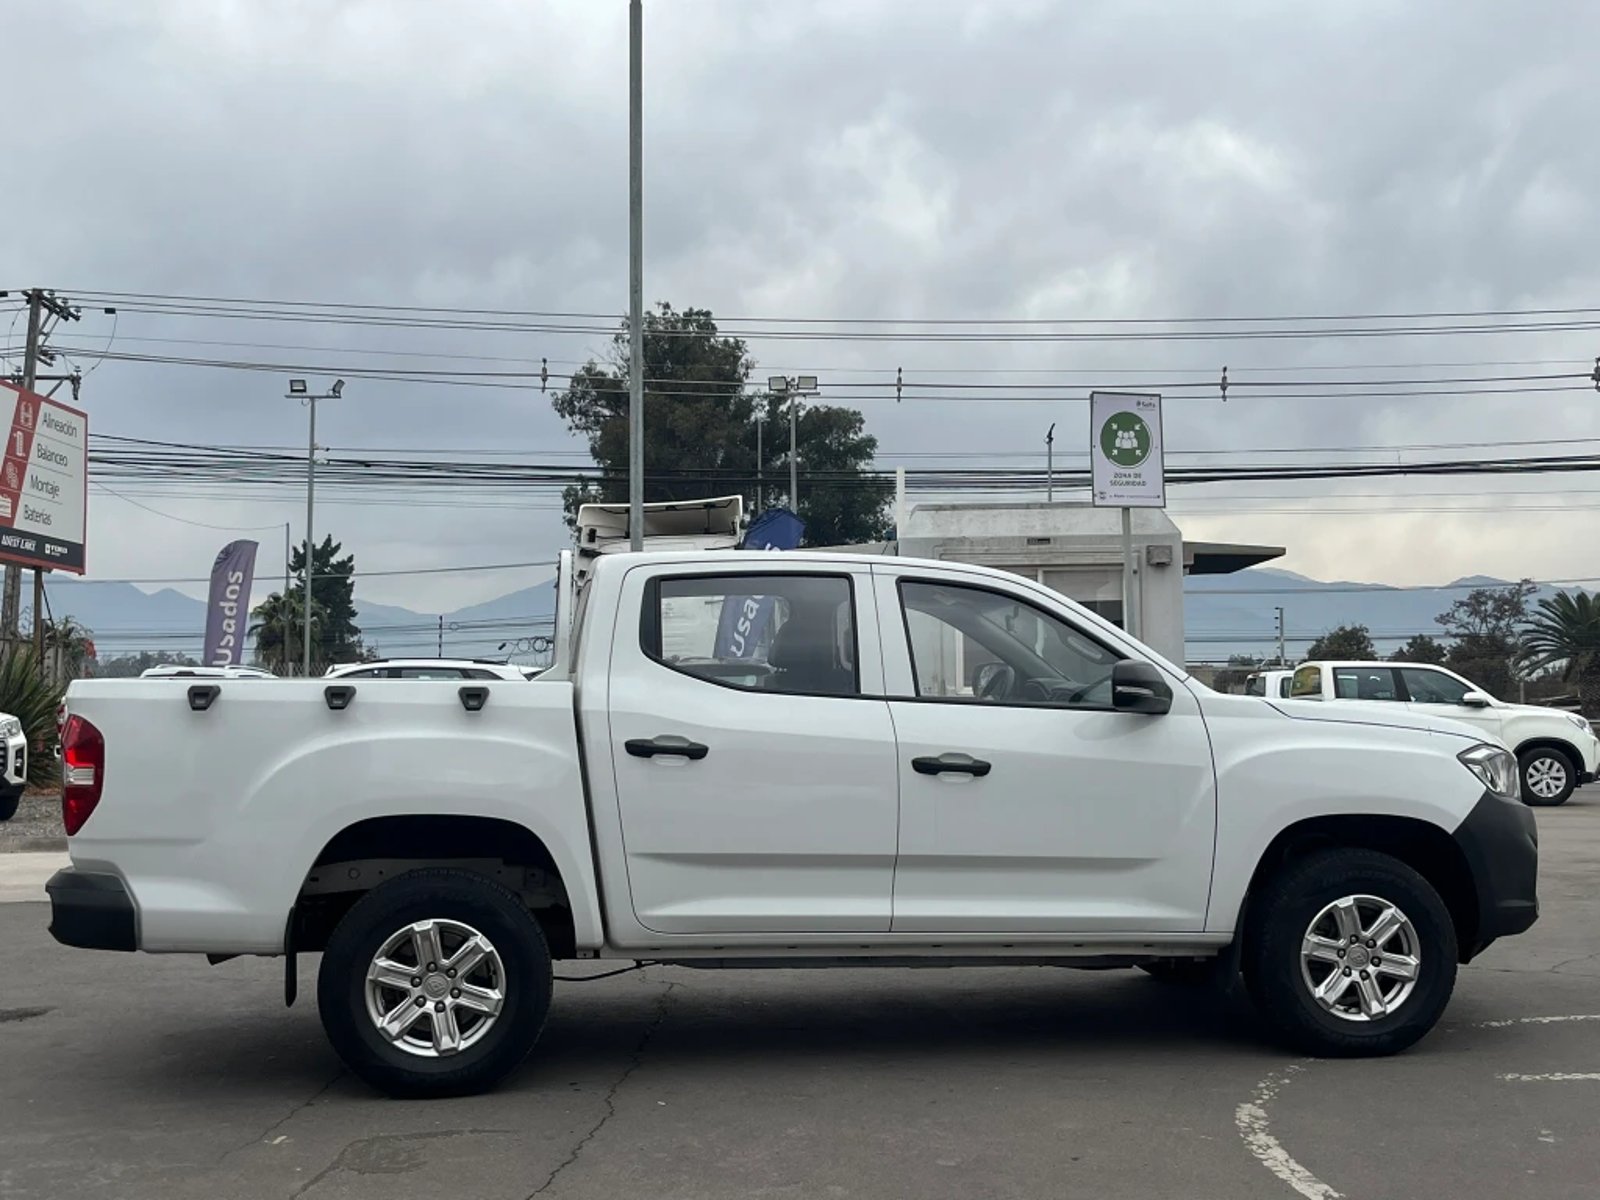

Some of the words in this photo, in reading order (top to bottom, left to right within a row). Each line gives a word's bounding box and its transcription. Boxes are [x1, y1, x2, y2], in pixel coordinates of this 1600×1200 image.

[42, 412, 77, 438] Alineación
[37, 443, 68, 467] Balanceo
[30, 474, 60, 499] Montaje
[212, 571, 243, 665] Usados
[730, 594, 764, 657] Usa
